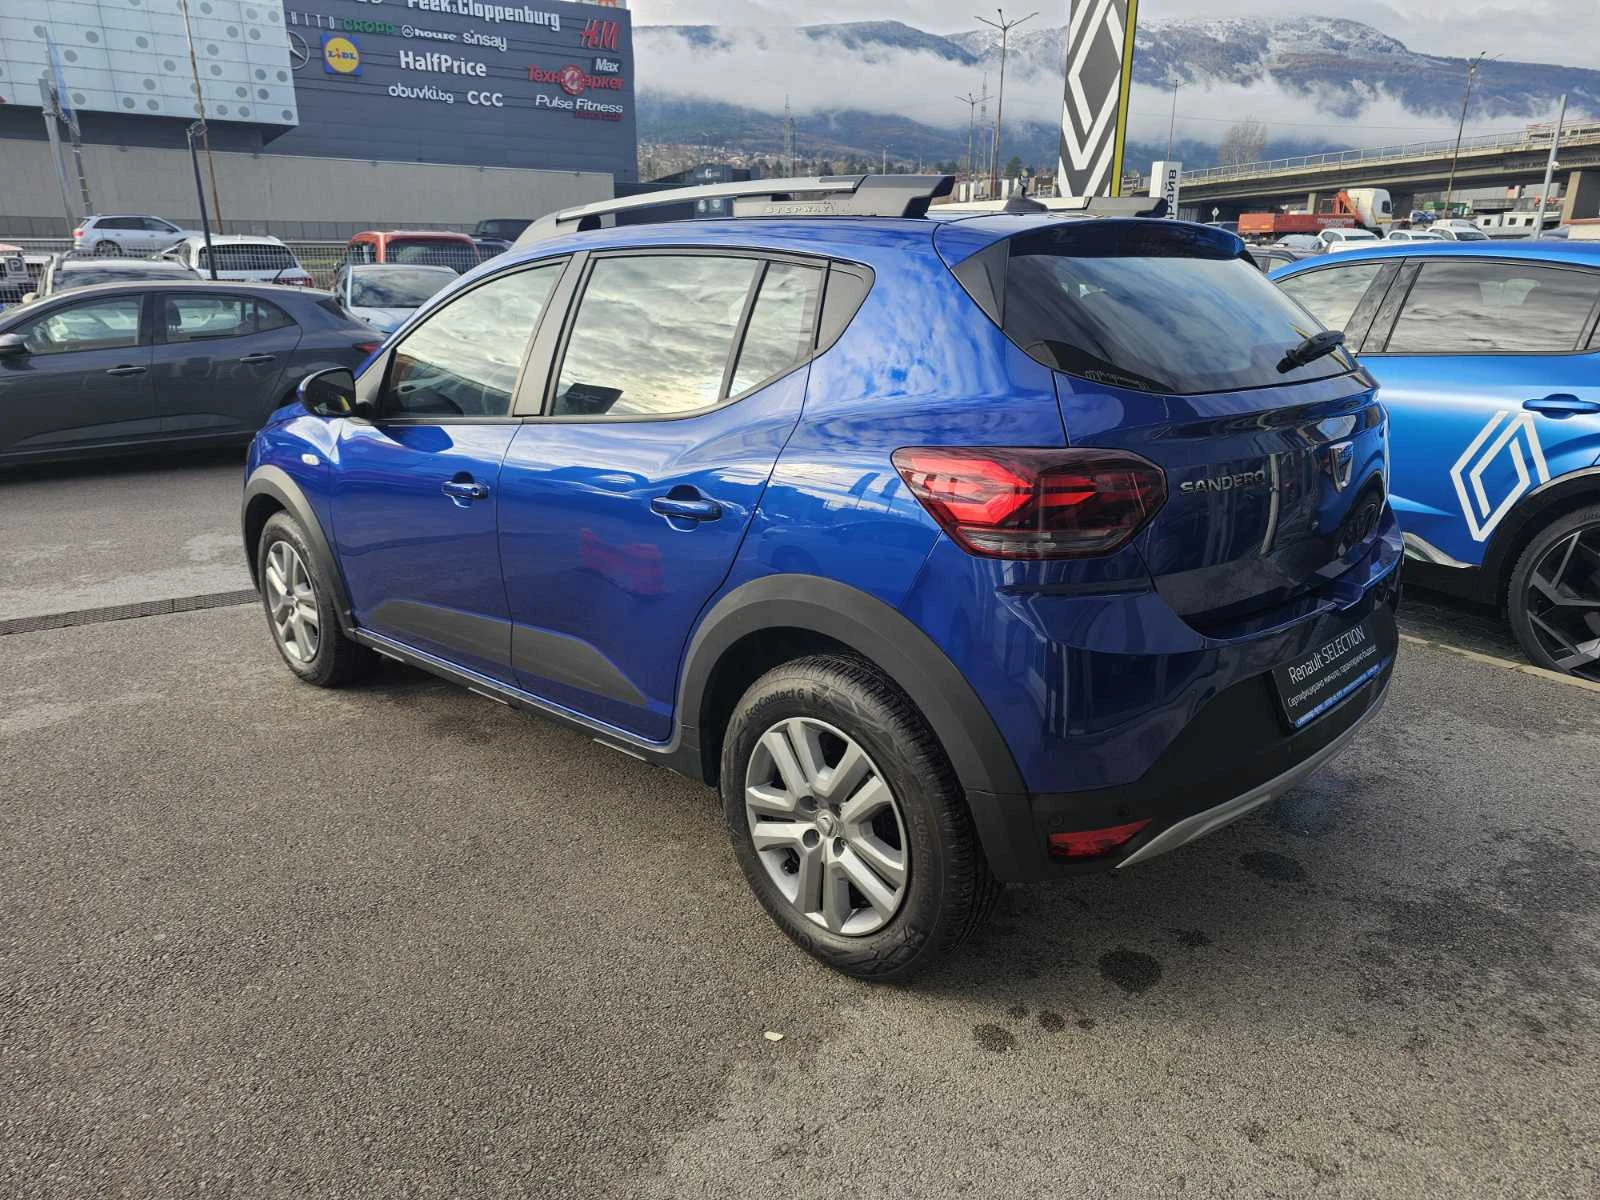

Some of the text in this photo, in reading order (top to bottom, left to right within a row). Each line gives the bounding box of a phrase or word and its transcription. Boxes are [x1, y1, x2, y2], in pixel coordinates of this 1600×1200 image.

[462, 29, 508, 51] sinsay
[399, 50, 487, 77] HalfPrice
[595, 58, 619, 72] Max
[388, 82, 454, 104] obuvki.bg
[467, 90, 504, 107] CCC
[535, 94, 624, 113] Pulse Fitness
[1164, 169, 1177, 219] райв
[1180, 470, 1266, 495] SANDERO
[1287, 625, 1366, 685] Renault SELECTION
